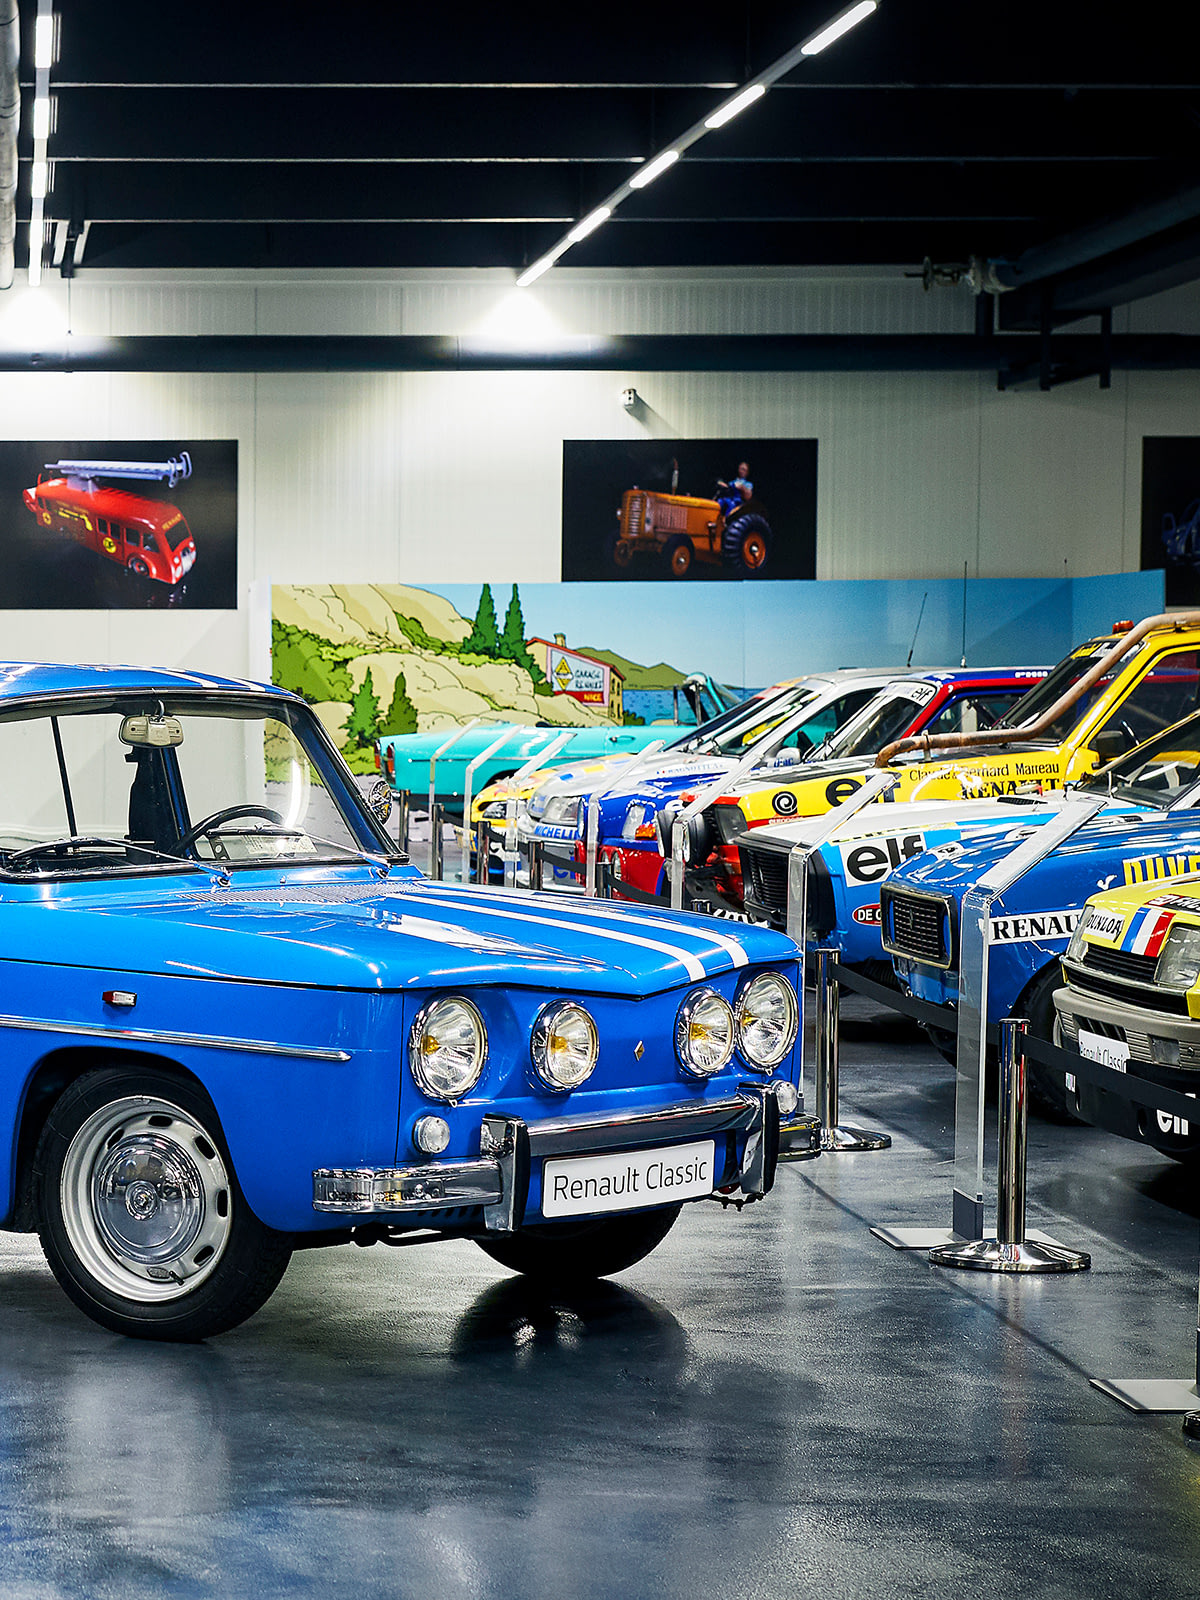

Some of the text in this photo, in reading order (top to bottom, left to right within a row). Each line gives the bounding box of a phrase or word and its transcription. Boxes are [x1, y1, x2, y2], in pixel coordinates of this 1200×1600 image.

[1015, 763, 1060, 776] Marreau
[847, 835, 924, 882] elf
[857, 908, 873, 921] DE
[553, 1157, 708, 1201] Renault Classic
